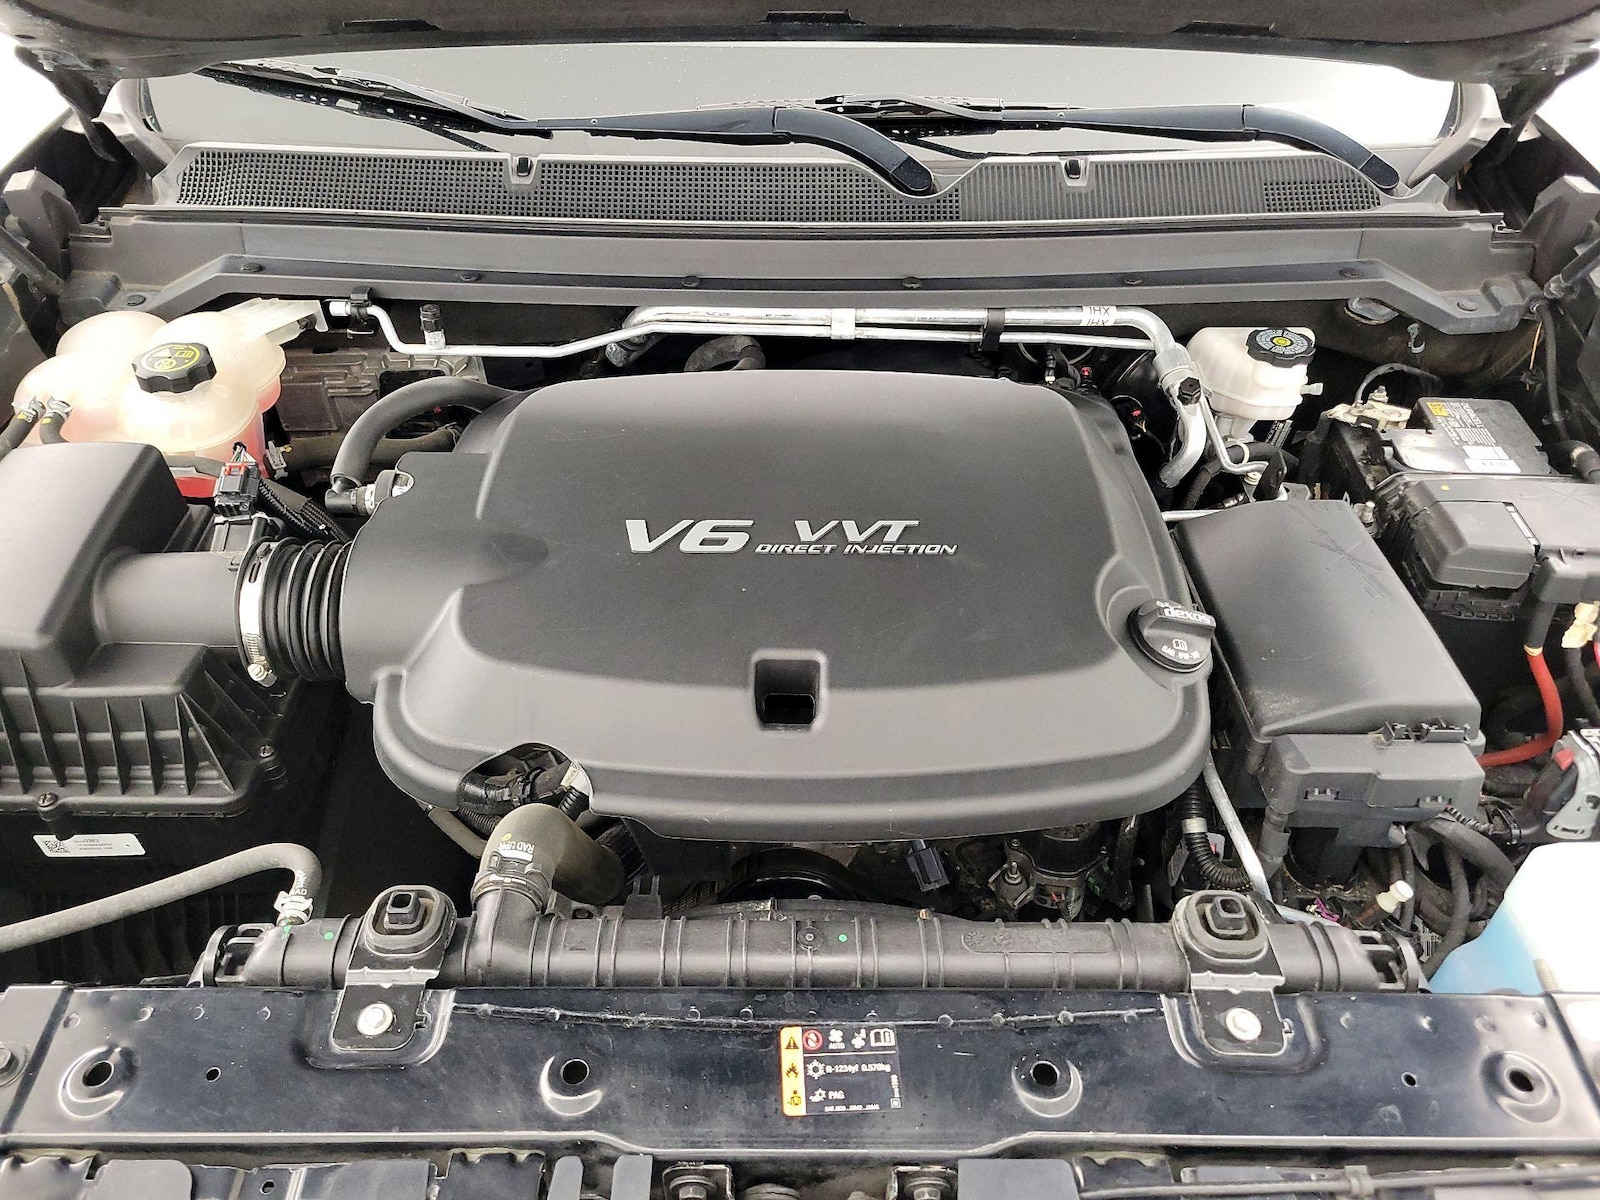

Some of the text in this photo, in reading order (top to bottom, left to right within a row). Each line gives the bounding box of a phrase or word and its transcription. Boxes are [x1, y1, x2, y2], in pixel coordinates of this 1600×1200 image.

[625, 519, 920, 554] V6 VVT
[754, 543, 959, 555] DIRECT INJECTION
[1164, 605, 1211, 625] dexos
[517, 841, 535, 854] RAD
[828, 1090, 845, 1099] PAG
